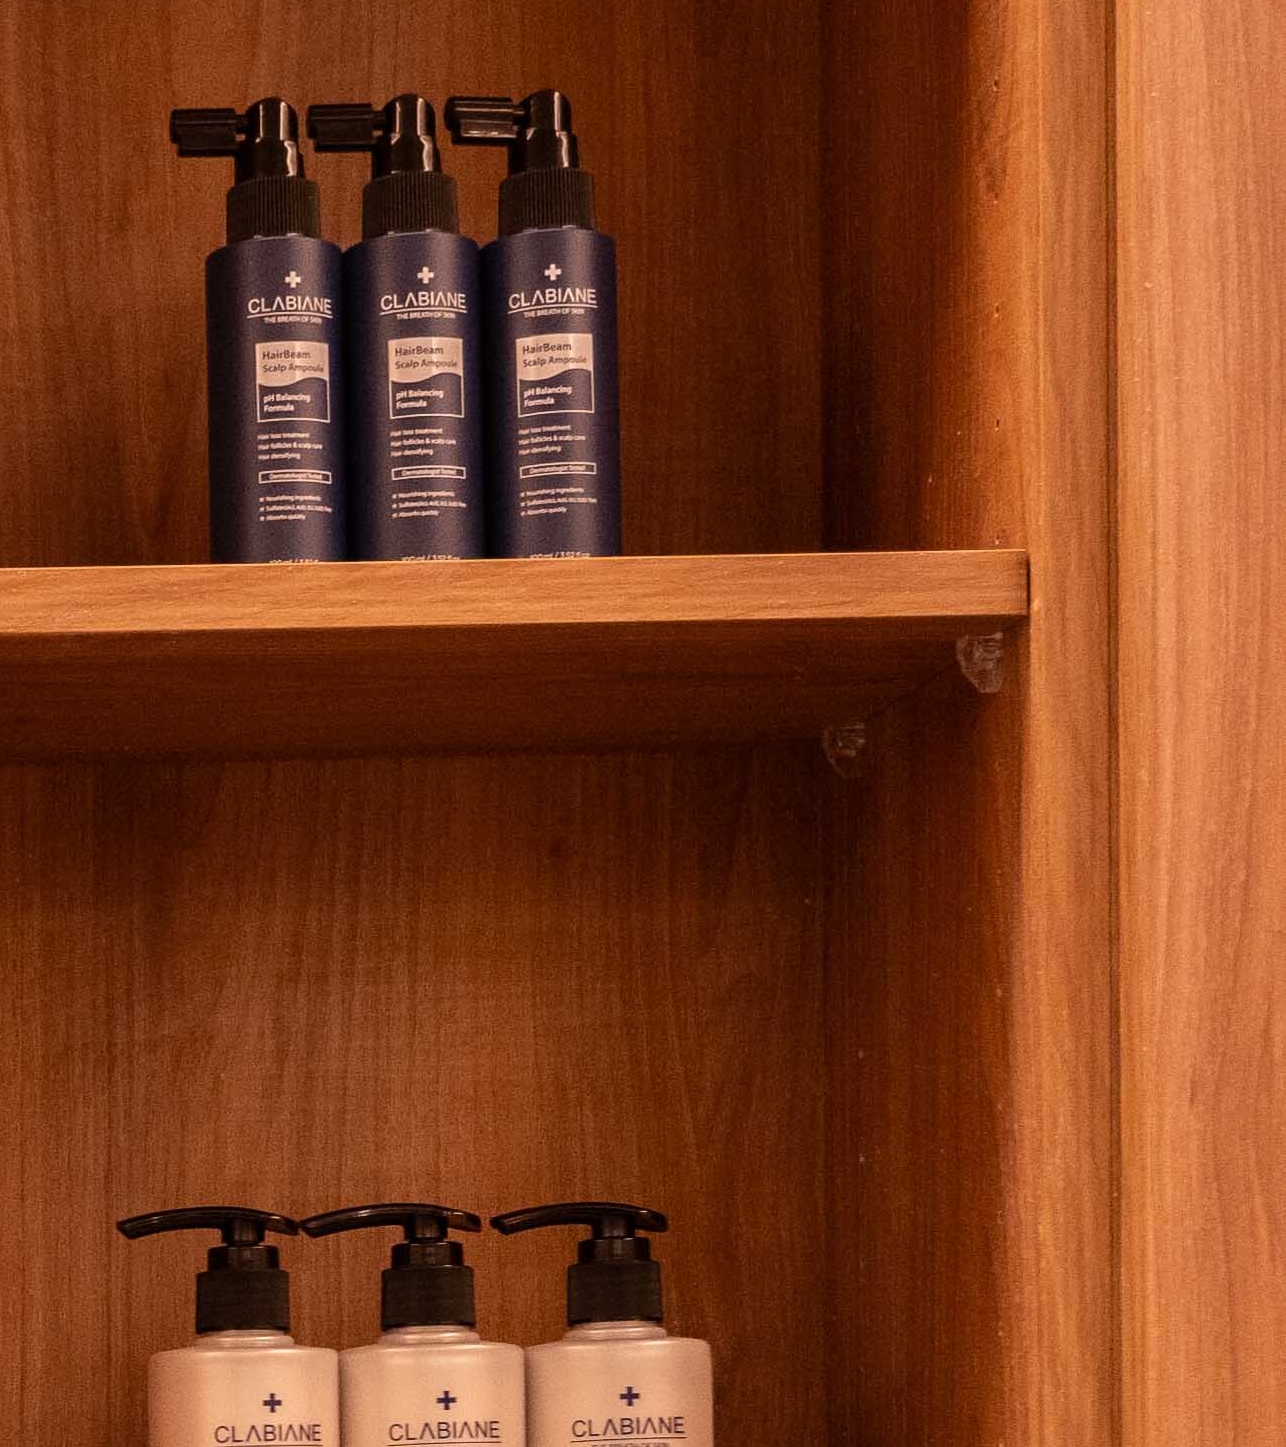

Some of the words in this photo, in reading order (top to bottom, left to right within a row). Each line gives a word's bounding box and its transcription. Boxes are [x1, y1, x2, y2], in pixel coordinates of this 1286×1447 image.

[380, 291, 466, 311] CLABIANE
[508, 287, 597, 309] CLABIANE
[247, 296, 332, 315] CLABIANE
[262, 349, 311, 361] HairBeam
[394, 345, 444, 357] HairBeam
[522, 342, 572, 356] HairBeam
[395, 359, 419, 370] Scalp
[421, 359, 458, 370] Ampoule
[523, 357, 547, 368] Scalp
[549, 355, 587, 366] Ampoule
[262, 364, 285, 374] Scalp
[287, 363, 324, 374] Ampoule
[263, 393, 275, 404] pH
[275, 392, 311, 404] Balancing
[395, 390, 408, 401] pH
[408, 389, 445, 399] Balancing
[523, 388, 535, 399] pH
[535, 385, 573, 396] Balancing
[263, 403, 295, 412] Formula
[395, 399, 428, 410] Formula
[523, 396, 555, 408] Formula
[388, 1420, 501, 1442] CLABIANE
[571, 1416, 686, 1438] CLABIANE
[214, 1423, 322, 1444] CLABIANE
